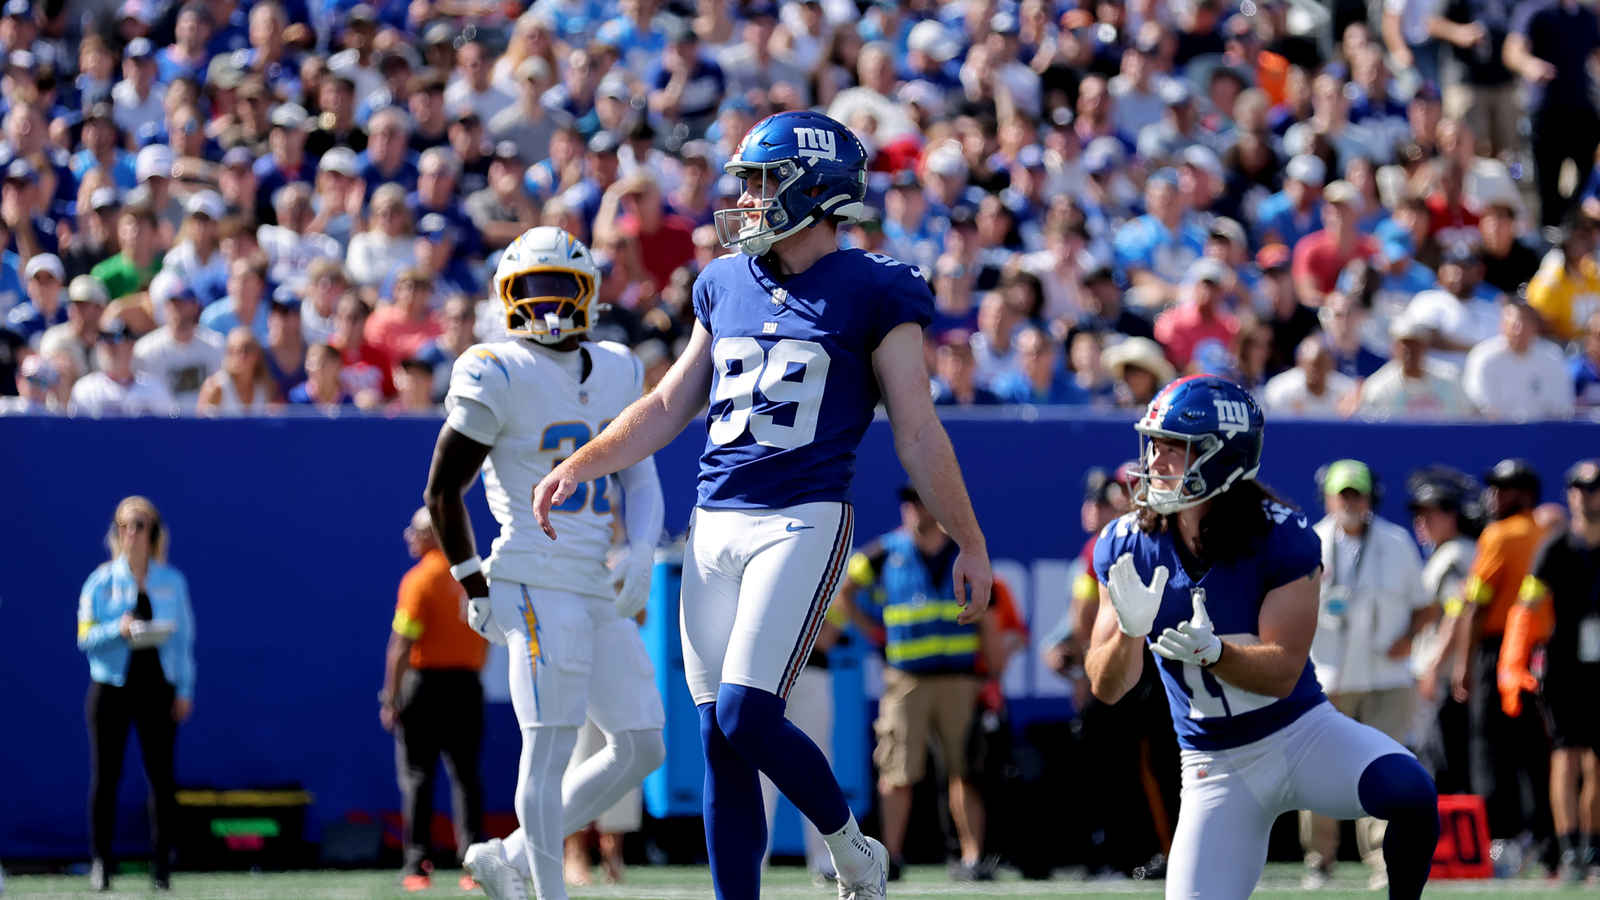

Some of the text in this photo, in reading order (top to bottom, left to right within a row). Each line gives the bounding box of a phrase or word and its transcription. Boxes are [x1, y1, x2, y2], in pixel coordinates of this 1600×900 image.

[793, 127, 836, 159] ny
[761, 322, 778, 334] ny
[709, 337, 831, 450] 99
[1213, 399, 1250, 433] ny
